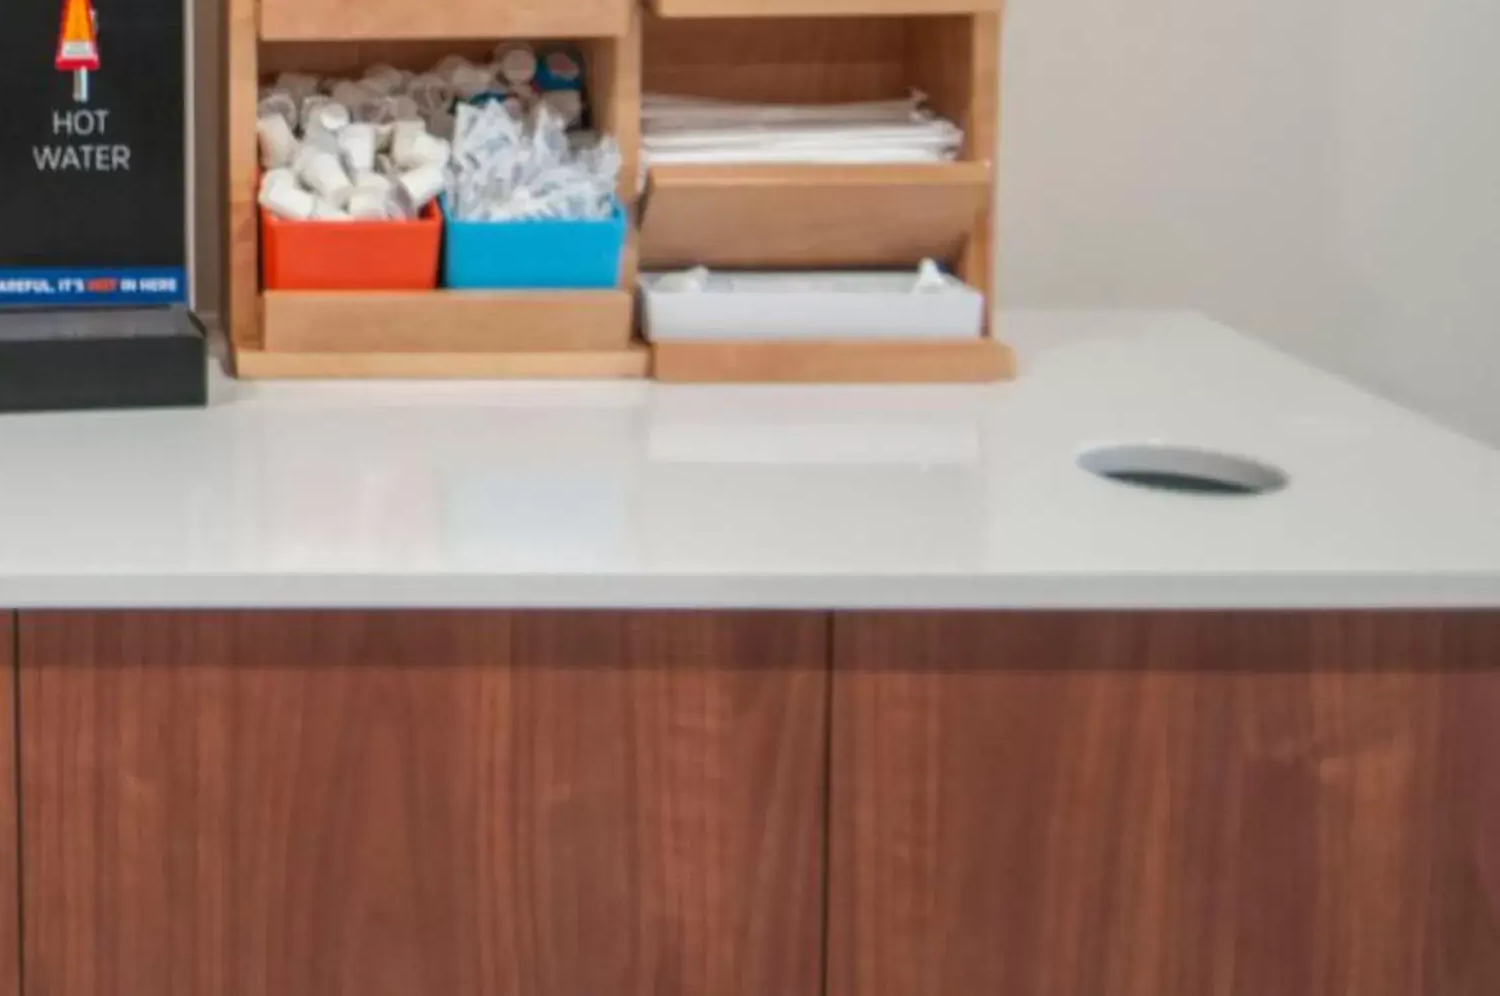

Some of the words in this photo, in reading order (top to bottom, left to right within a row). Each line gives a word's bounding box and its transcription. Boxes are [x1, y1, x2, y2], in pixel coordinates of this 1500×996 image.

[53, 109, 110, 135] HOT
[32, 144, 131, 172] WATER
[57, 277, 85, 293] IT'S
[120, 277, 136, 293] IN
[139, 277, 177, 293] HERE
